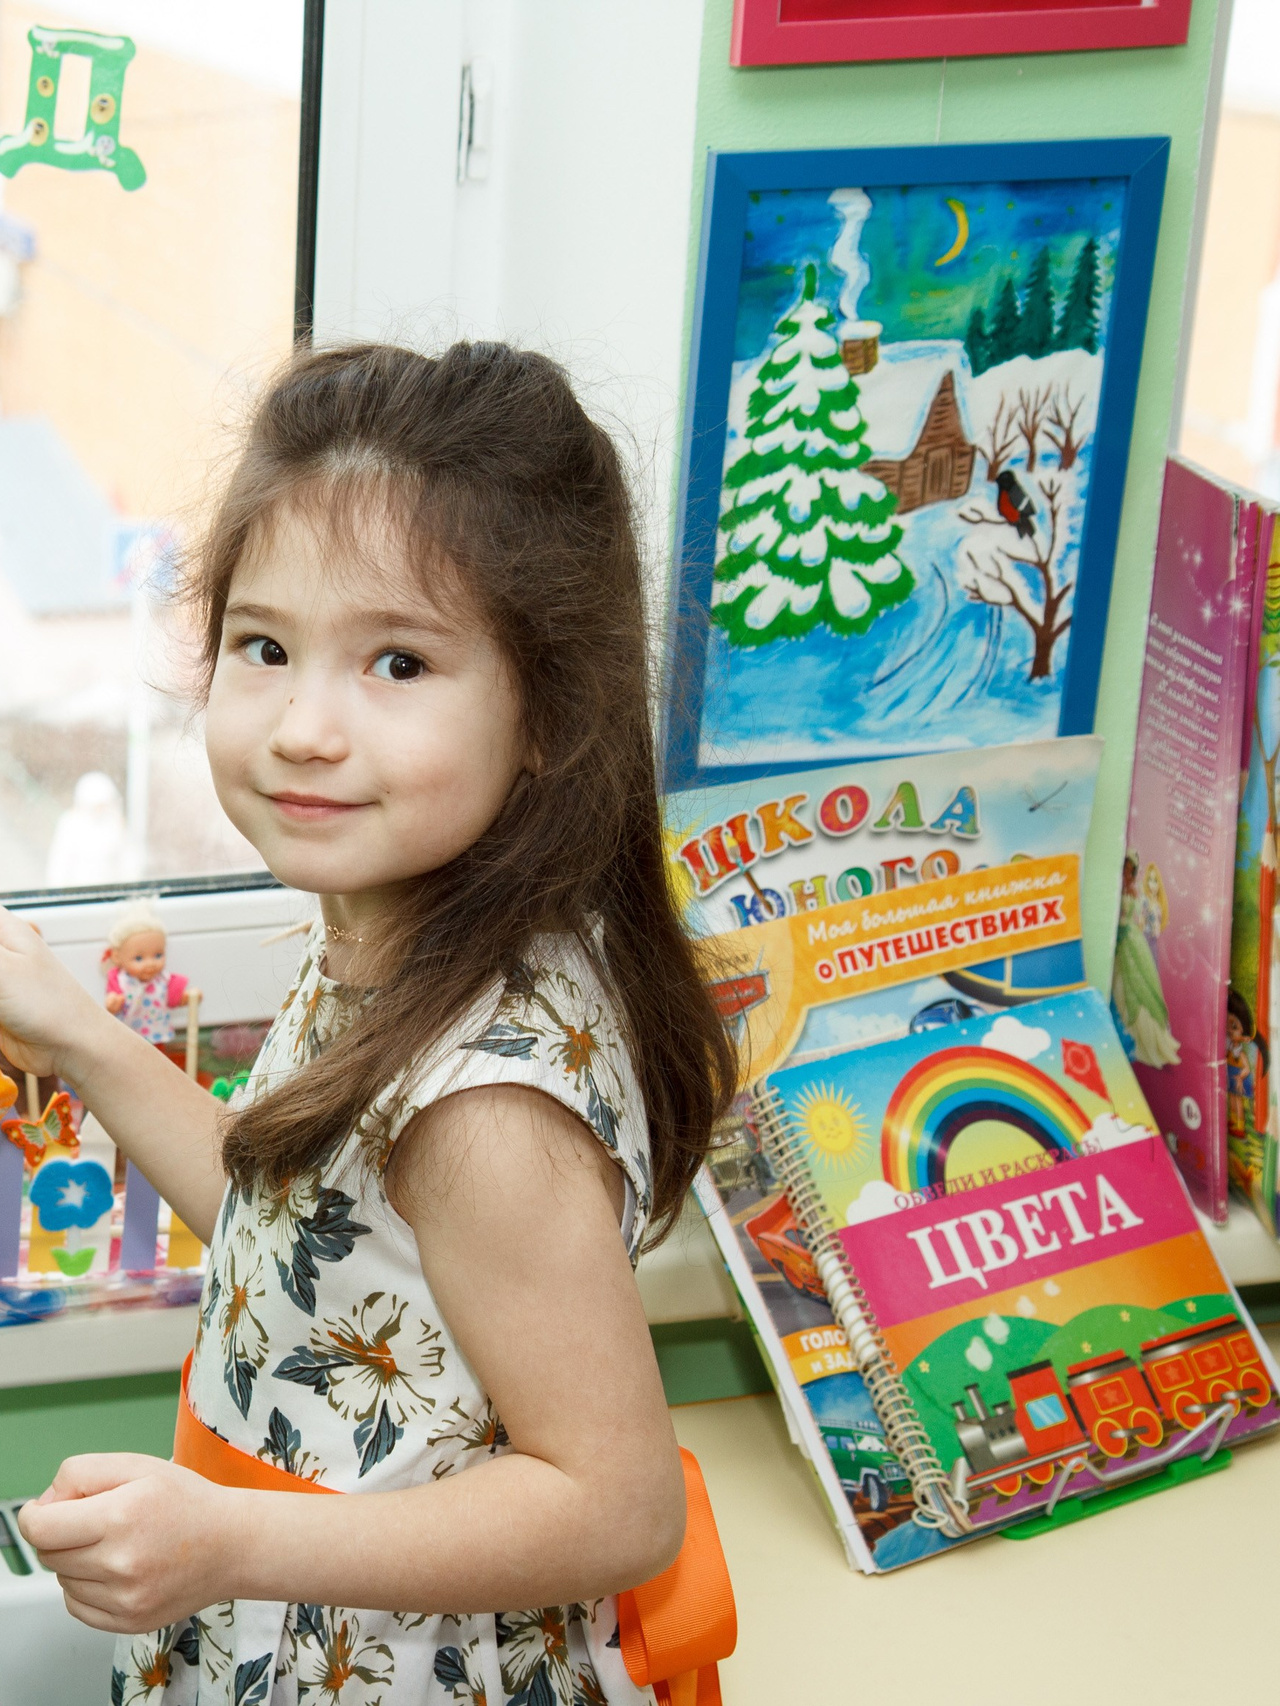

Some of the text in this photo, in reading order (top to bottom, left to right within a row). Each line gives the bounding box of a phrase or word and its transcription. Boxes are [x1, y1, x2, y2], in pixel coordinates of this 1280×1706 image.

[679, 781, 981, 897] ШКОЛА
[729, 848, 962, 928] ЮНОГО
[807, 870, 1067, 946] Моя большая книжка
[838, 898, 1064, 978] ПУТЕШЕСТВИЯХ
[894, 1137, 1104, 1210] ОБВЕДИ И РАСКРАСЬ!
[906, 1173, 1144, 1291] ЦВЕТА
